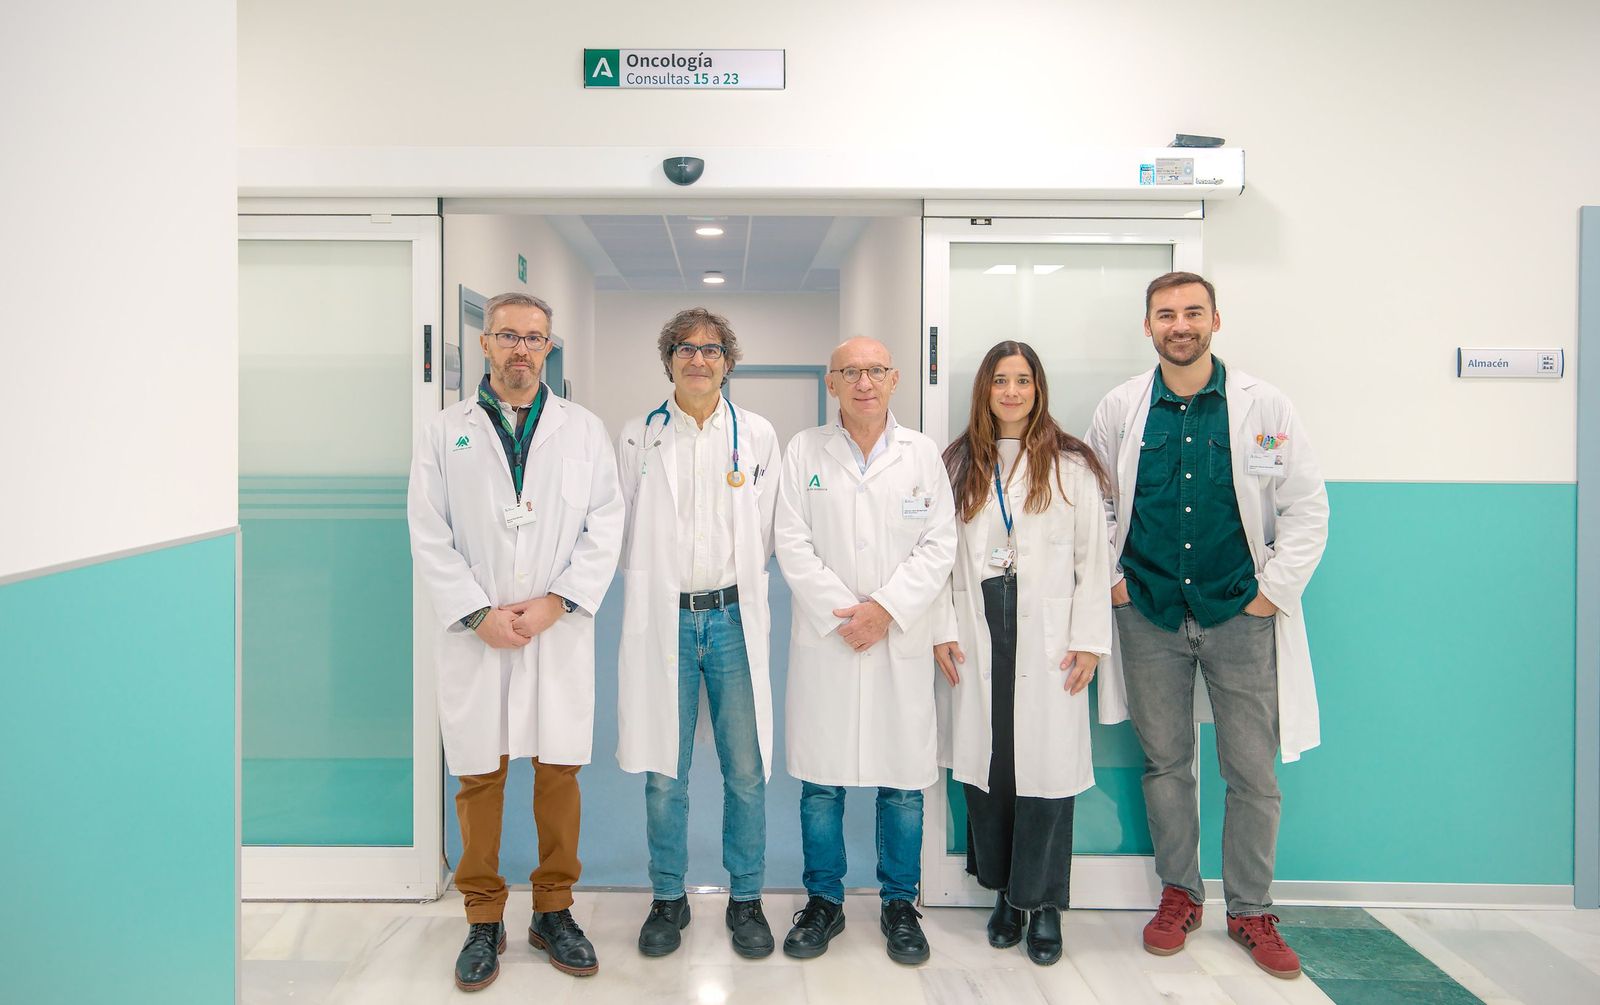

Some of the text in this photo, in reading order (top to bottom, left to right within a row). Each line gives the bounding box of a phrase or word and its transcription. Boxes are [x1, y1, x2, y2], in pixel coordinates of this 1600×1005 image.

[626, 52, 713, 72] Oncología
[626, 72, 739, 85] Consultas 15 a 23
[1467, 358, 1509, 368] Almacén
